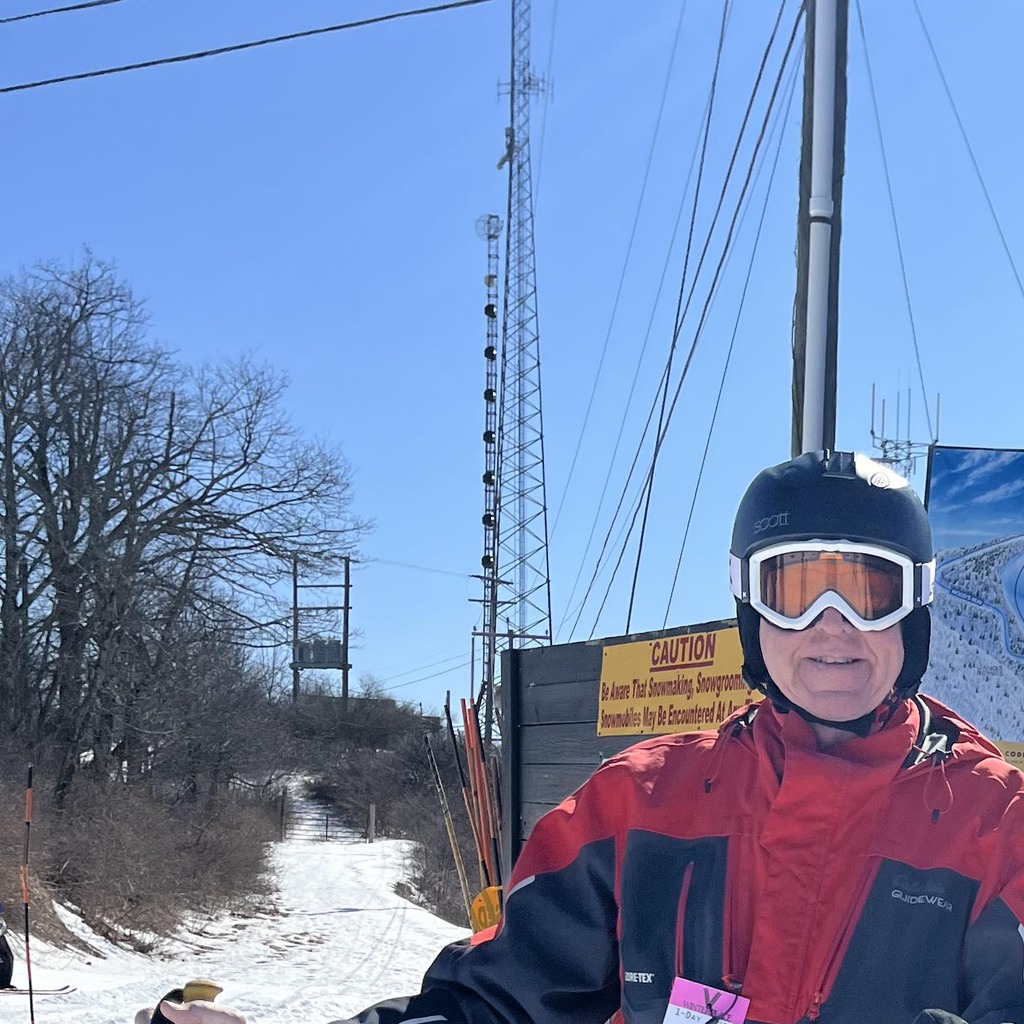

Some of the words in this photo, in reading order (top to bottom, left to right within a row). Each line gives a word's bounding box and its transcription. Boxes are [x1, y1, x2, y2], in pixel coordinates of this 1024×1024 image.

[754, 510, 790, 535] SCOTT
[652, 634, 716, 665] CAUTION
[602, 682, 609, 701] Be
[611, 681, 630, 700] Aware
[632, 679, 647, 698] That
[649, 675, 694, 700] Snowmaking,
[696, 671, 751, 697] Snowgroom
[601, 707, 641, 729] Snowmobiles
[643, 705, 656, 731] May
[657, 705, 666, 726] Be
[668, 702, 715, 725] Encountered
[716, 701, 725, 723] At
